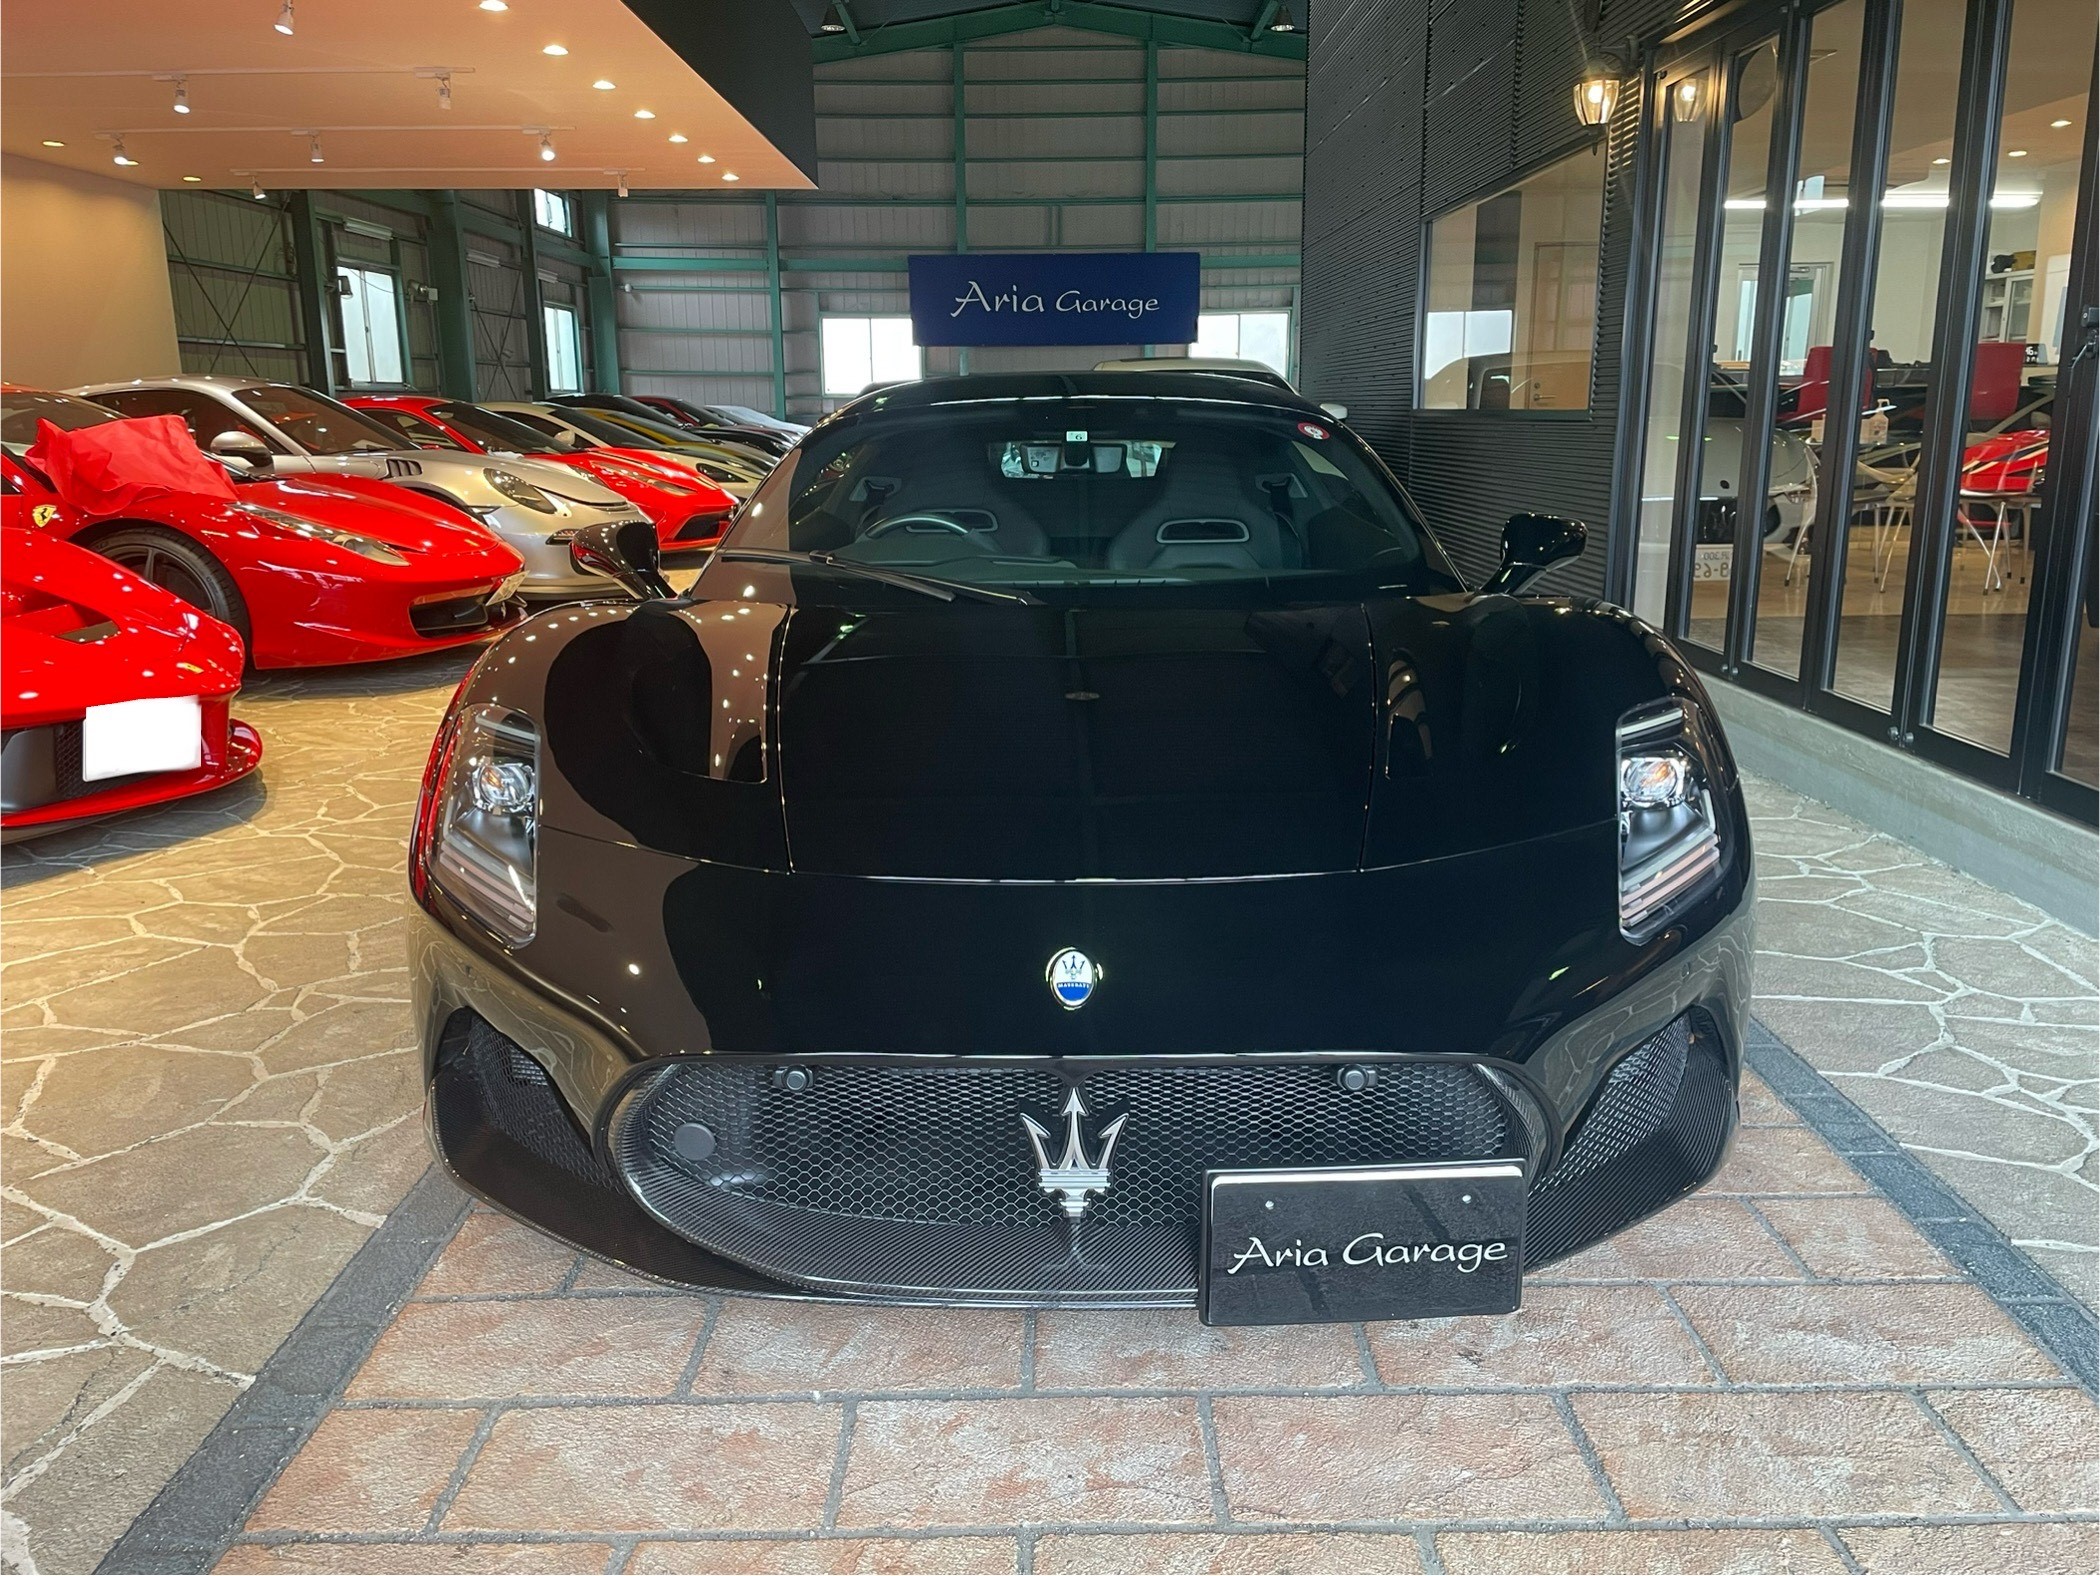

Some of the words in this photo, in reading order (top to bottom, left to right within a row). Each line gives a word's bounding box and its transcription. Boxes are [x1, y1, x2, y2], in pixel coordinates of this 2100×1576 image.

[950, 281, 1045, 318] Aria
[1055, 290, 1160, 319] Garage
[1227, 1236, 1329, 1275] Aria
[1342, 1232, 1508, 1273] Garage
